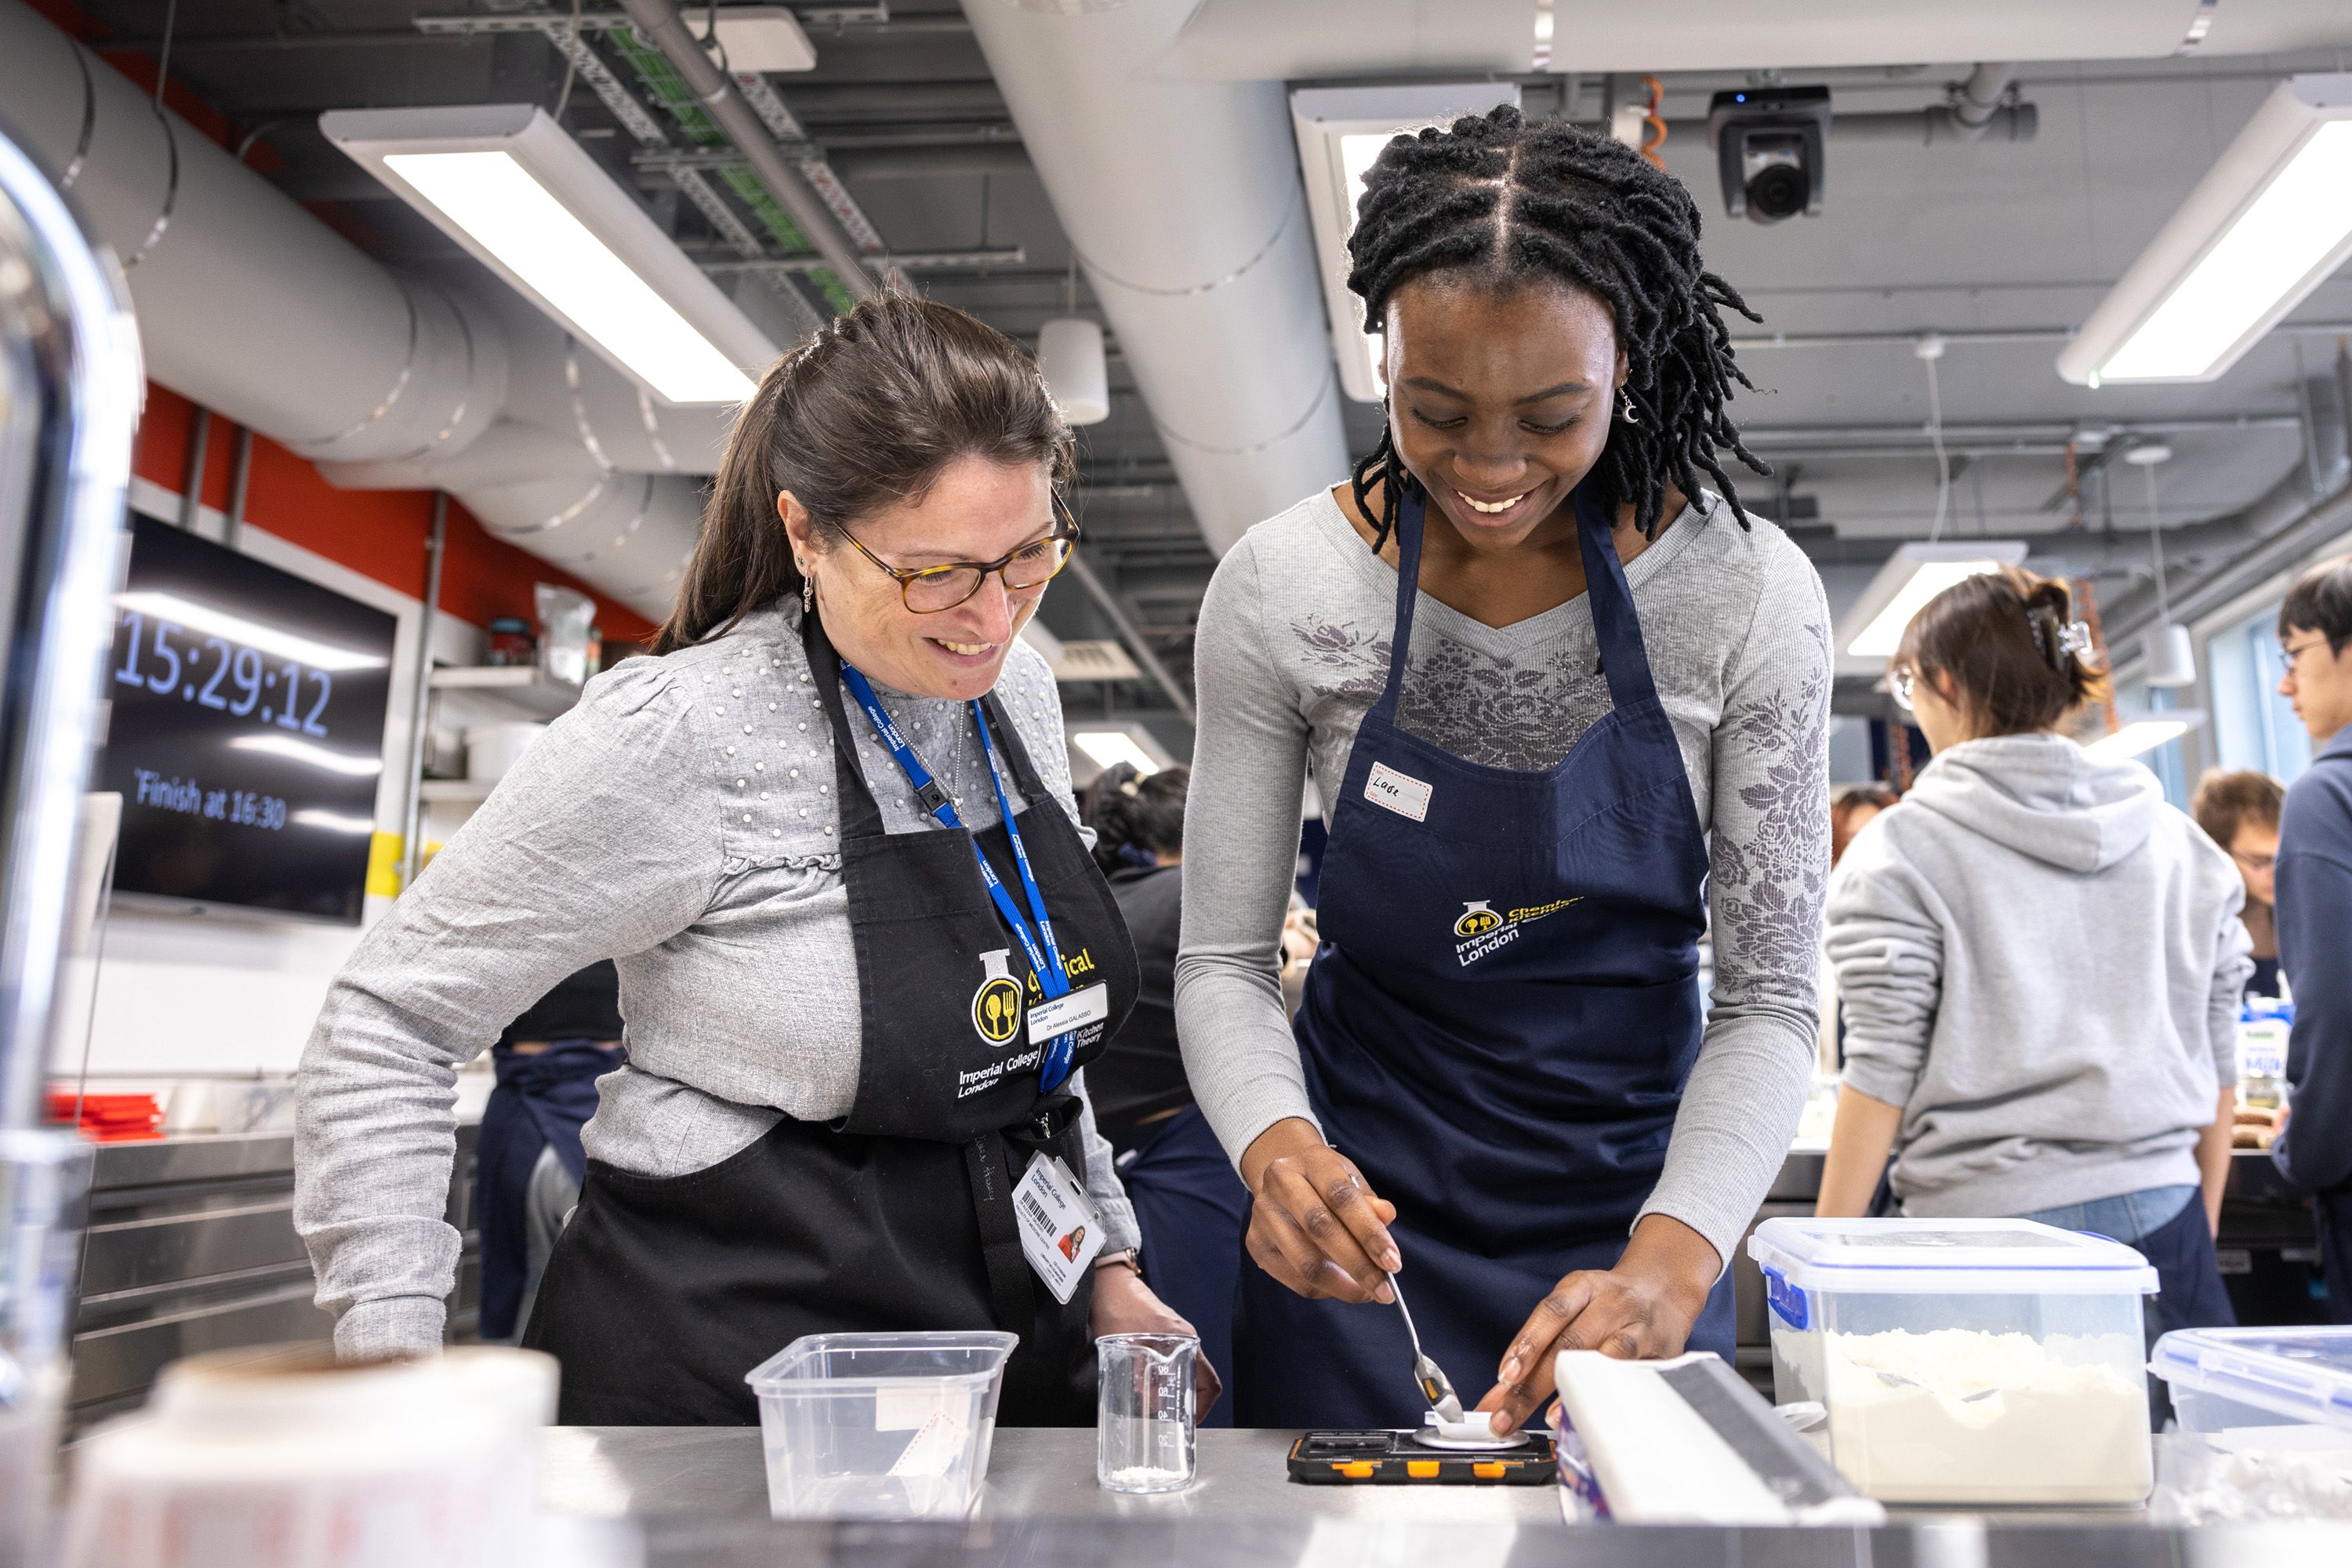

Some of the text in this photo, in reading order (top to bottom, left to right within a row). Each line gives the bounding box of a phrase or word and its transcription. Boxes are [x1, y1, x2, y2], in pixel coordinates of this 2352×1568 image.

[115, 612, 332, 739] 15:29:12
[867, 706, 900, 752] Imperial College
[887, 723, 906, 748] London
[204, 790, 227, 820] at
[230, 790, 286, 831] 16:30
[982, 860, 998, 884] London
[1040, 920, 1051, 946] London
[1456, 923, 1518, 953] Imperial
[1027, 946, 1042, 972] Imperial
[1032, 943, 1046, 969] London
[1459, 929, 1519, 967] London
[1030, 1003, 1064, 1018] Imperial College
[1031, 1015, 1048, 1025] London
[1053, 1019, 1069, 1029] Alessia
[1069, 1010, 1091, 1023] GALASSO
[1076, 1022, 1105, 1040] Kitchen
[1076, 1032, 1103, 1049] Theory
[959, 1050, 1039, 1085] Imperial College
[957, 1078, 999, 1098] London
[1031, 1174, 1047, 1198] London
[1036, 1167, 1066, 1210] Imperial College
